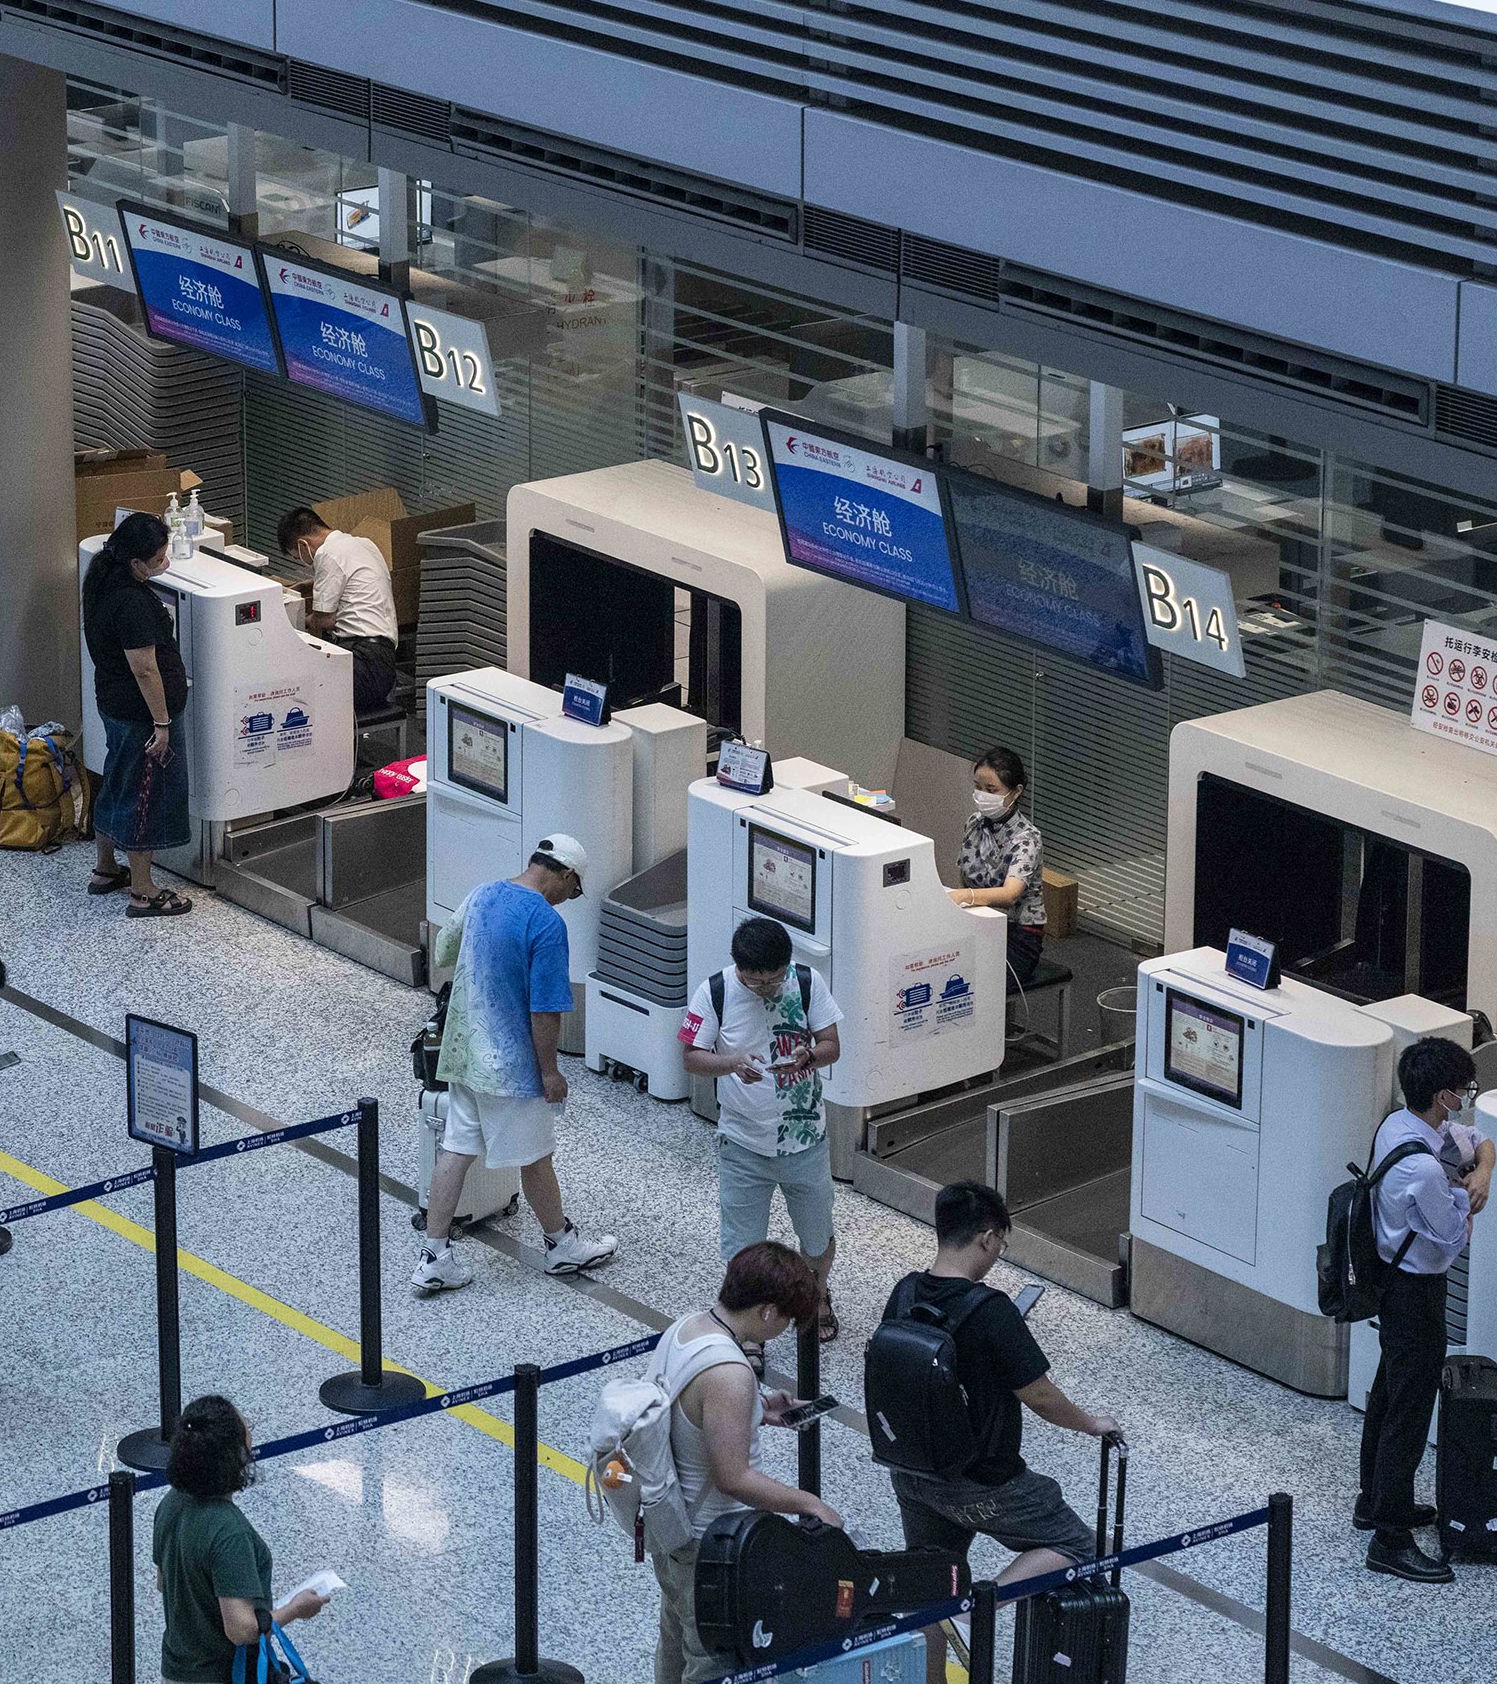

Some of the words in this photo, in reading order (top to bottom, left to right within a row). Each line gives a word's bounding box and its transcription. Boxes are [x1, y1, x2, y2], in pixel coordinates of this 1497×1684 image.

[63, 206, 124, 274] B11
[178, 274, 224, 309] 经济舱
[172, 299, 214, 324] ECONOMY
[215, 313, 242, 332] CLASS
[320, 321, 368, 358] 经济舱
[413, 319, 486, 395] B12
[312, 345, 356, 369] ECONOMY
[358, 361, 386, 380] CLASS
[686, 412, 764, 490] B13
[834, 496, 892, 537] 经济舱
[822, 522, 876, 550] ECONOMY
[878, 540, 913, 563] CLASS
[1018, 559, 1080, 600] 经济舱
[1142, 562, 1229, 652] B14
[1444, 636, 1497, 664] 托运行李安检
